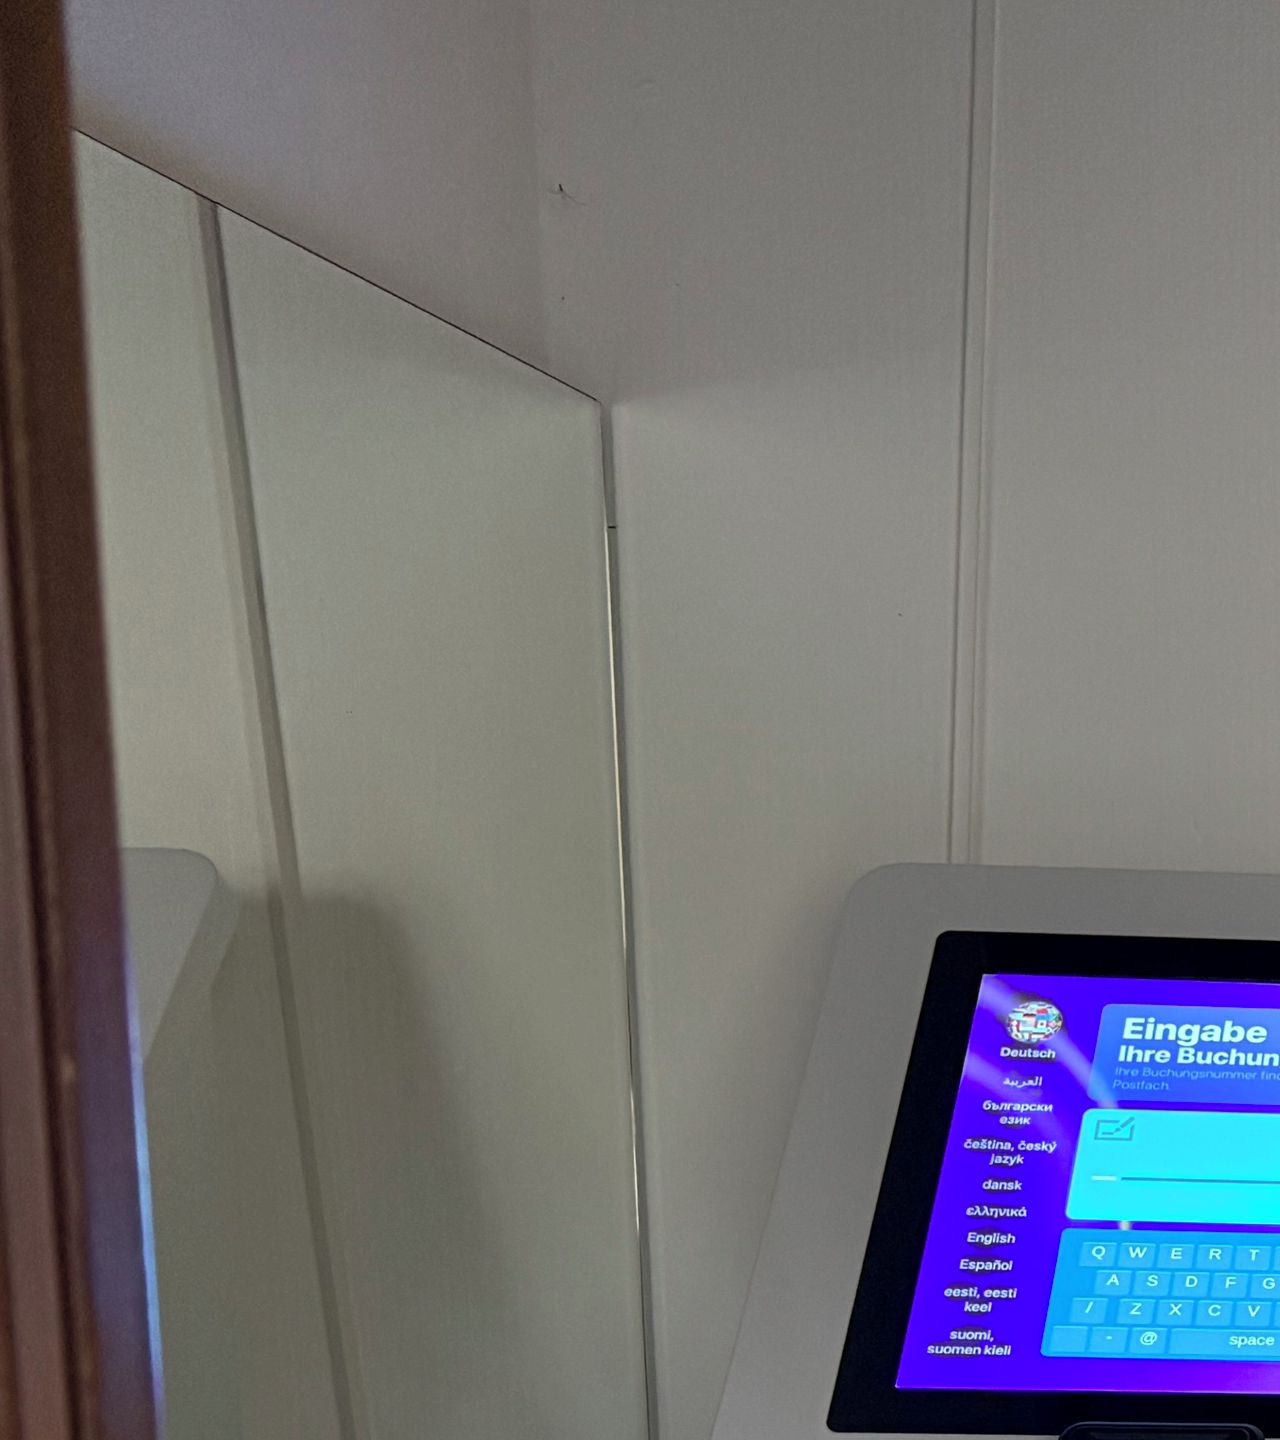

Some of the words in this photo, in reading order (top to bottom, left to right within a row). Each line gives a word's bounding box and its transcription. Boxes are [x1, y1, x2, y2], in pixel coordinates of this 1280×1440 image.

[1122, 1017, 1268, 1047] Eingabe
[1000, 1046, 1056, 1059] Deutsch
[1117, 1044, 1171, 1064] Ihre
[1115, 1067, 1139, 1077] Ihre
[1142, 1067, 1256, 1080] Buchungsnummer
[1003, 1076, 1043, 1088] العربية
[982, 1100, 1053, 1113] български
[999, 1115, 1031, 1125] език
[964, 1138, 1015, 1152] čeština,
[1017, 1140, 1057, 1154] český
[989, 1153, 1024, 1166] jazyk
[982, 1179, 1023, 1191] dansk
[965, 1205, 1028, 1219] ελληνικά
[966, 1232, 1016, 1247] English
[1091, 1245, 1106, 1260] Q
[1128, 1246, 1147, 1258] W
[1170, 1248, 1183, 1260] E
[1208, 1248, 1222, 1260] R
[1248, 1249, 1260, 1261] T
[959, 1258, 1013, 1273] Español
[1106, 1273, 1120, 1286] A
[1146, 1274, 1159, 1287] S
[1185, 1275, 1198, 1288] D
[1225, 1276, 1237, 1289] F
[1262, 1277, 1276, 1290] G
[944, 1287, 981, 1299] eesti,
[983, 1287, 1017, 1299] eesti
[963, 1301, 992, 1313] keel
[1129, 1303, 1142, 1315] Z
[1168, 1303, 1182, 1316] X
[1207, 1304, 1221, 1316] C
[1248, 1305, 1260, 1317] V
[949, 1330, 994, 1342] suomi,
[1228, 1335, 1275, 1348] space
[927, 1344, 982, 1356] suomen
[983, 1344, 1011, 1356] kieli
